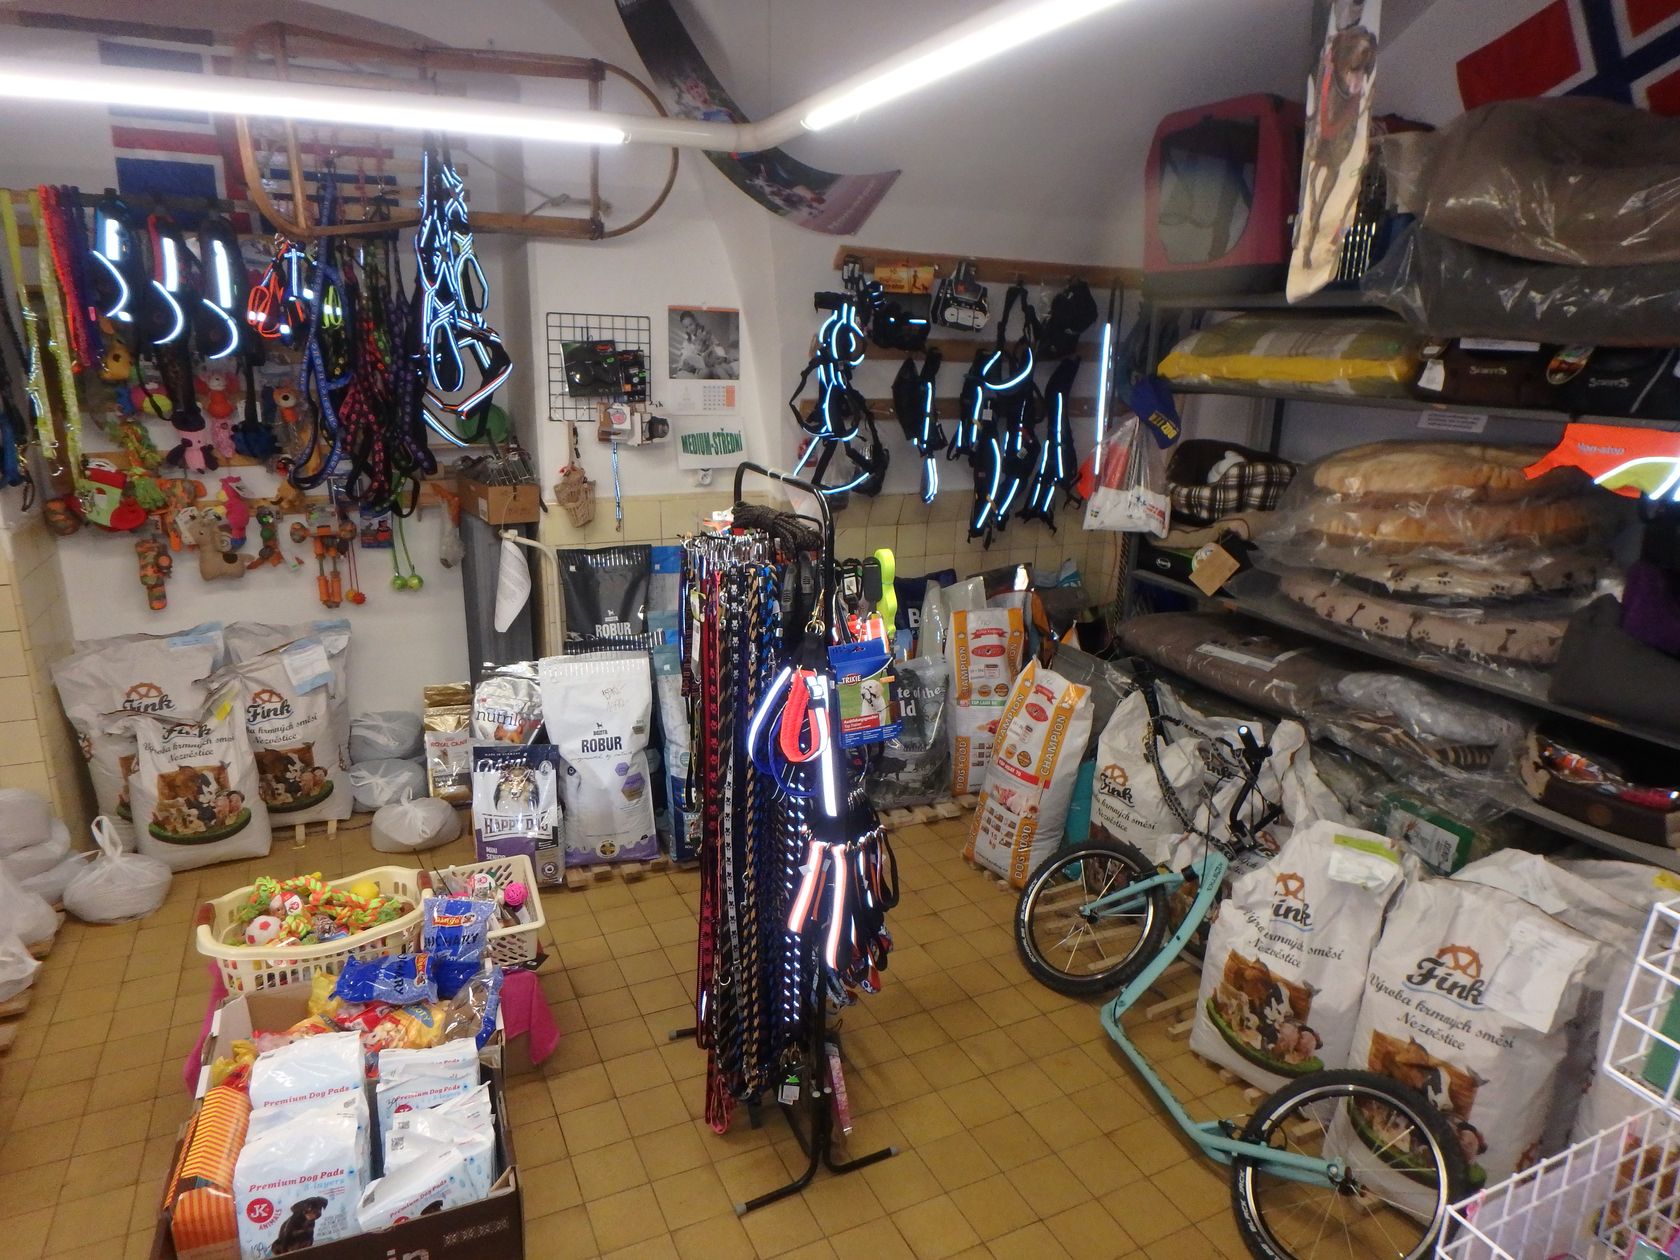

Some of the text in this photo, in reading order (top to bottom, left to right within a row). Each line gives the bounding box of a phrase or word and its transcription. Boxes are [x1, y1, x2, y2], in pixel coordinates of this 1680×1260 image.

[595, 622, 632, 638] ROBUR
[842, 675, 862, 684] TRIXIE
[247, 699, 294, 723] Fink
[581, 736, 623, 753] ROBUR
[1041, 715, 1067, 776] CHAMPION
[1100, 772, 1133, 804] Fink
[1014, 855, 1026, 879] DOG
[1272, 897, 1312, 927] ink
[1248, 937, 1301, 968] Nezvěstice
[1307, 946, 1344, 961] směsí
[1406, 957, 1486, 1006] Fink
[1370, 972, 1516, 1049] Výroba krmných směsí
[1397, 1011, 1467, 1051] Nezvěstice
[264, 1085, 350, 1107] Premium Dog Pads
[397, 1084, 461, 1101] Premium Dog Pads
[249, 1168, 345, 1193] Premium Dog Pads
[250, 1203, 269, 1218] JK
[389, 1180, 448, 1218] Premium Dog Pads
[258, 1207, 283, 1231] ANIMALS
